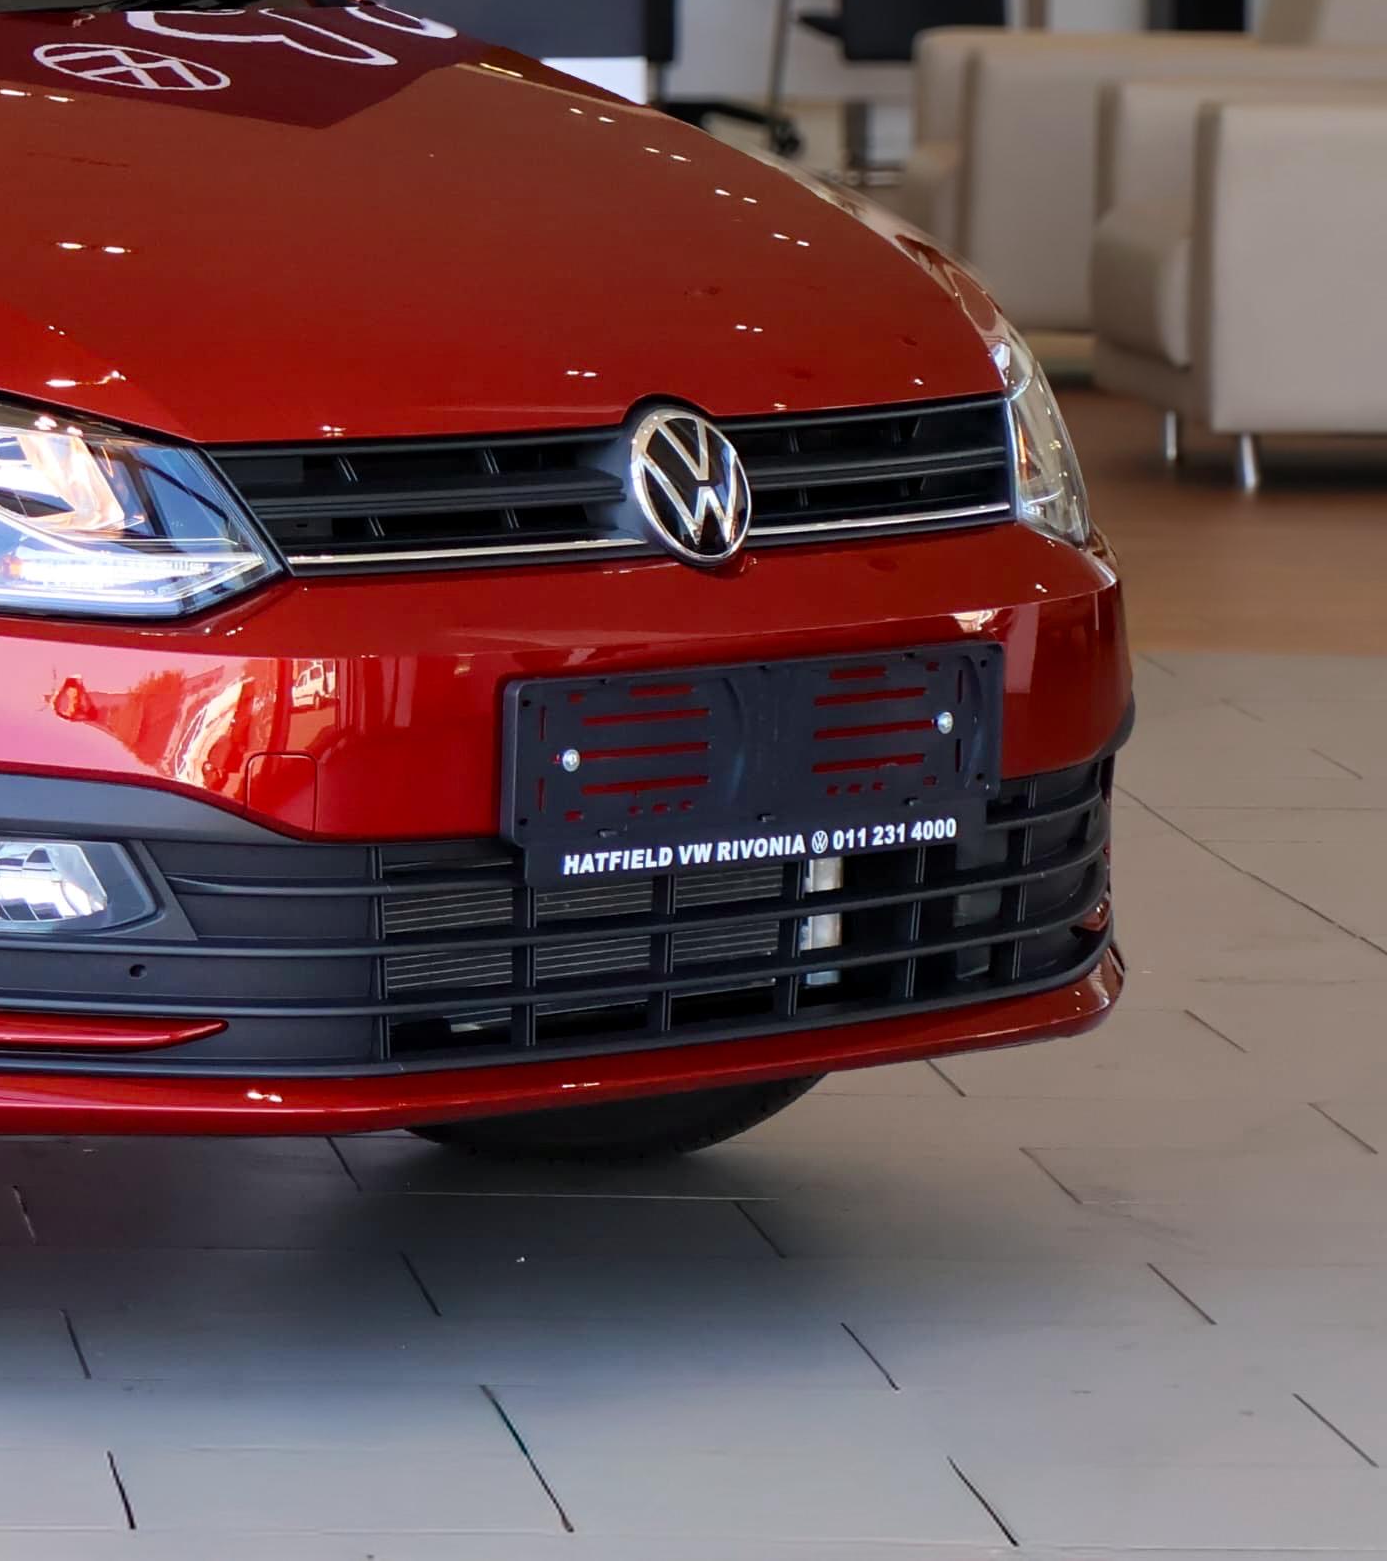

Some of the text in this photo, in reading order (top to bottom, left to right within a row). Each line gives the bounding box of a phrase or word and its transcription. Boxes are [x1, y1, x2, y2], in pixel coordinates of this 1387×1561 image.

[563, 846, 673, 875] HATFIELD
[678, 842, 713, 865] VW
[716, 834, 806, 862] RIVONIA
[832, 827, 868, 850] 011
[872, 823, 906, 846] 231
[910, 817, 958, 841] 4000
